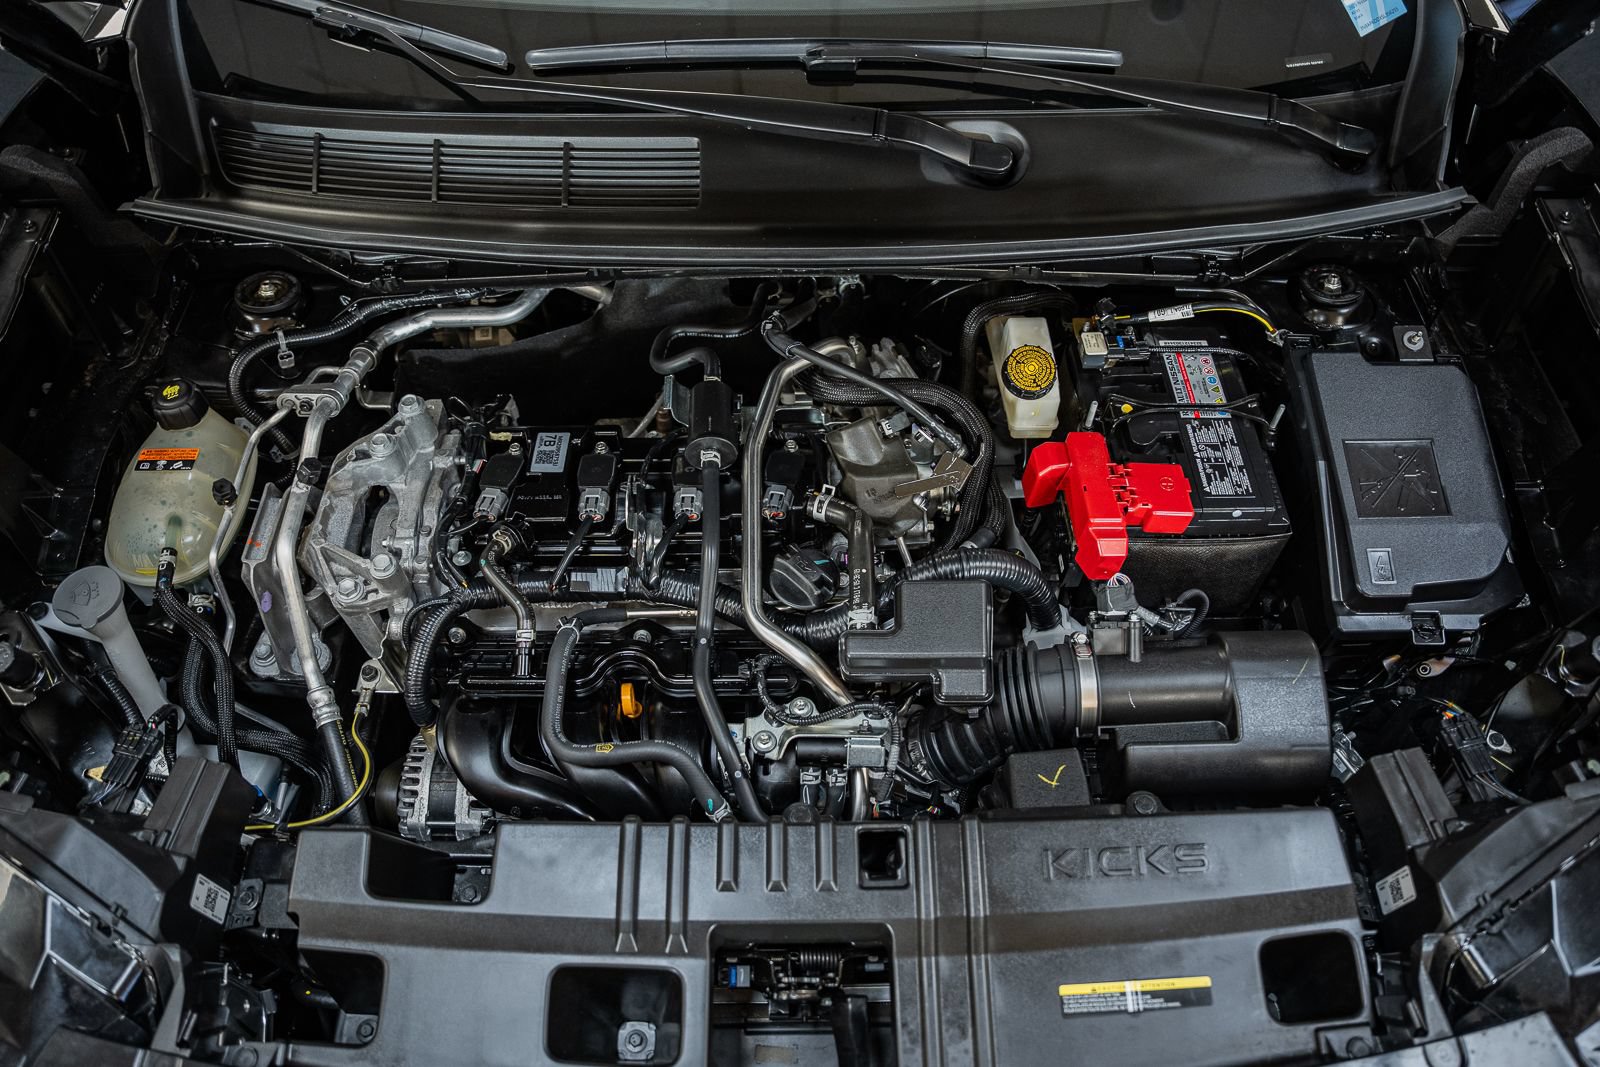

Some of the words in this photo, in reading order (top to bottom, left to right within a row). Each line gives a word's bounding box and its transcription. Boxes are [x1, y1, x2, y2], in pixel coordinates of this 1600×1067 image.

[1165, 354, 1180, 385] NISSAN
[544, 435, 557, 447] 7B
[1042, 843, 1210, 881] KICKS
